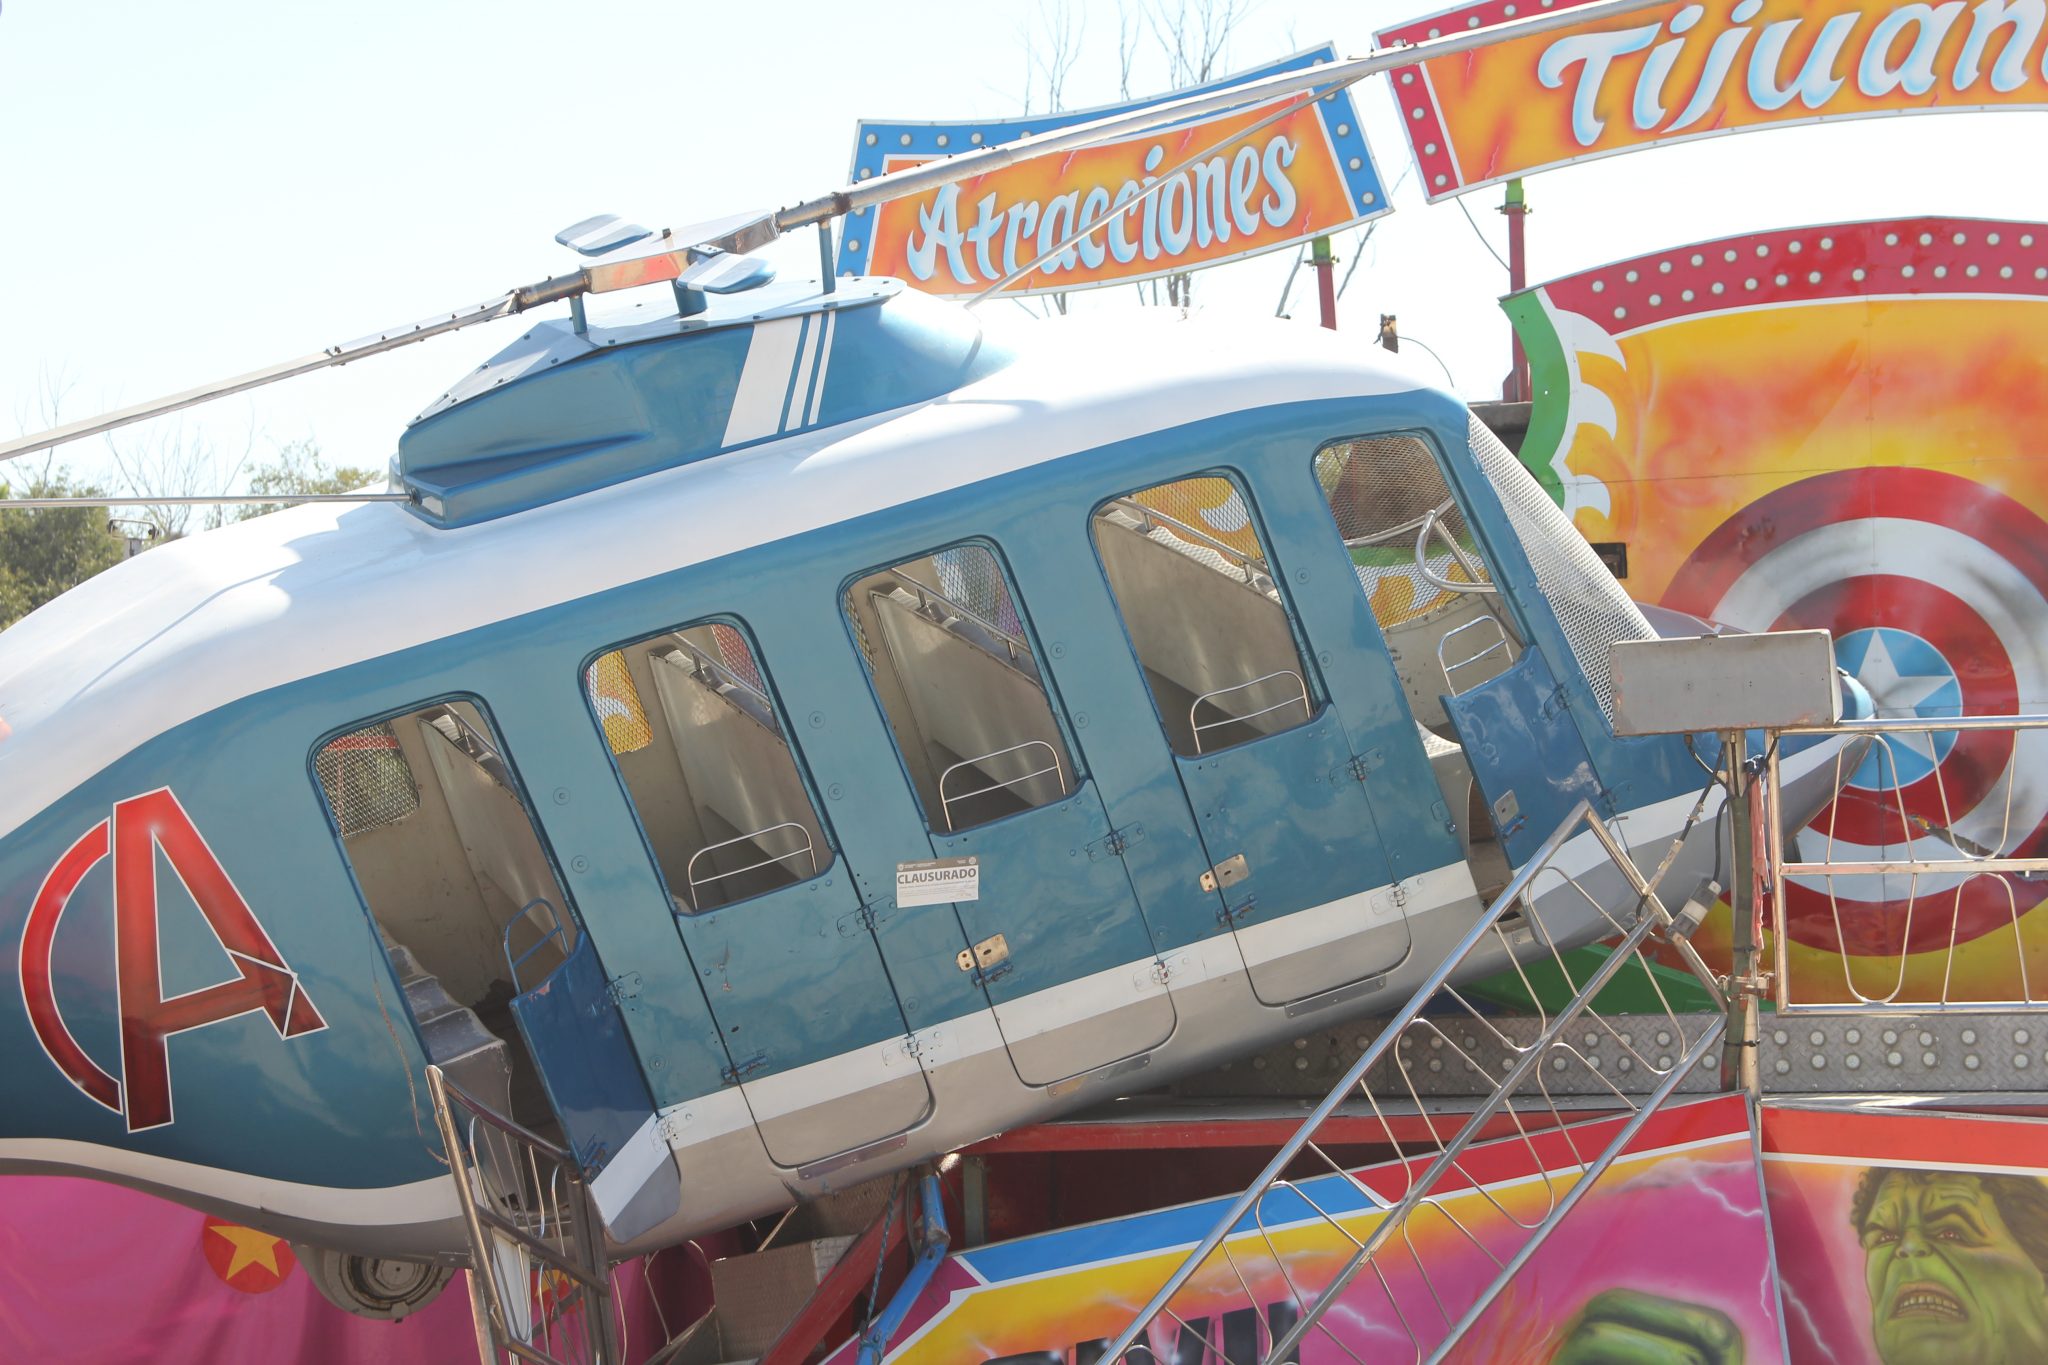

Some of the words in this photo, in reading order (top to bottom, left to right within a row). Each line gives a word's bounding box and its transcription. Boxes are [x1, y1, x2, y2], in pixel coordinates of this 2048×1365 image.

[1538, 0, 2048, 146] Tijuan
[907, 135, 1297, 285] Atracciones
[897, 868, 976, 884] CLAUSURADO
